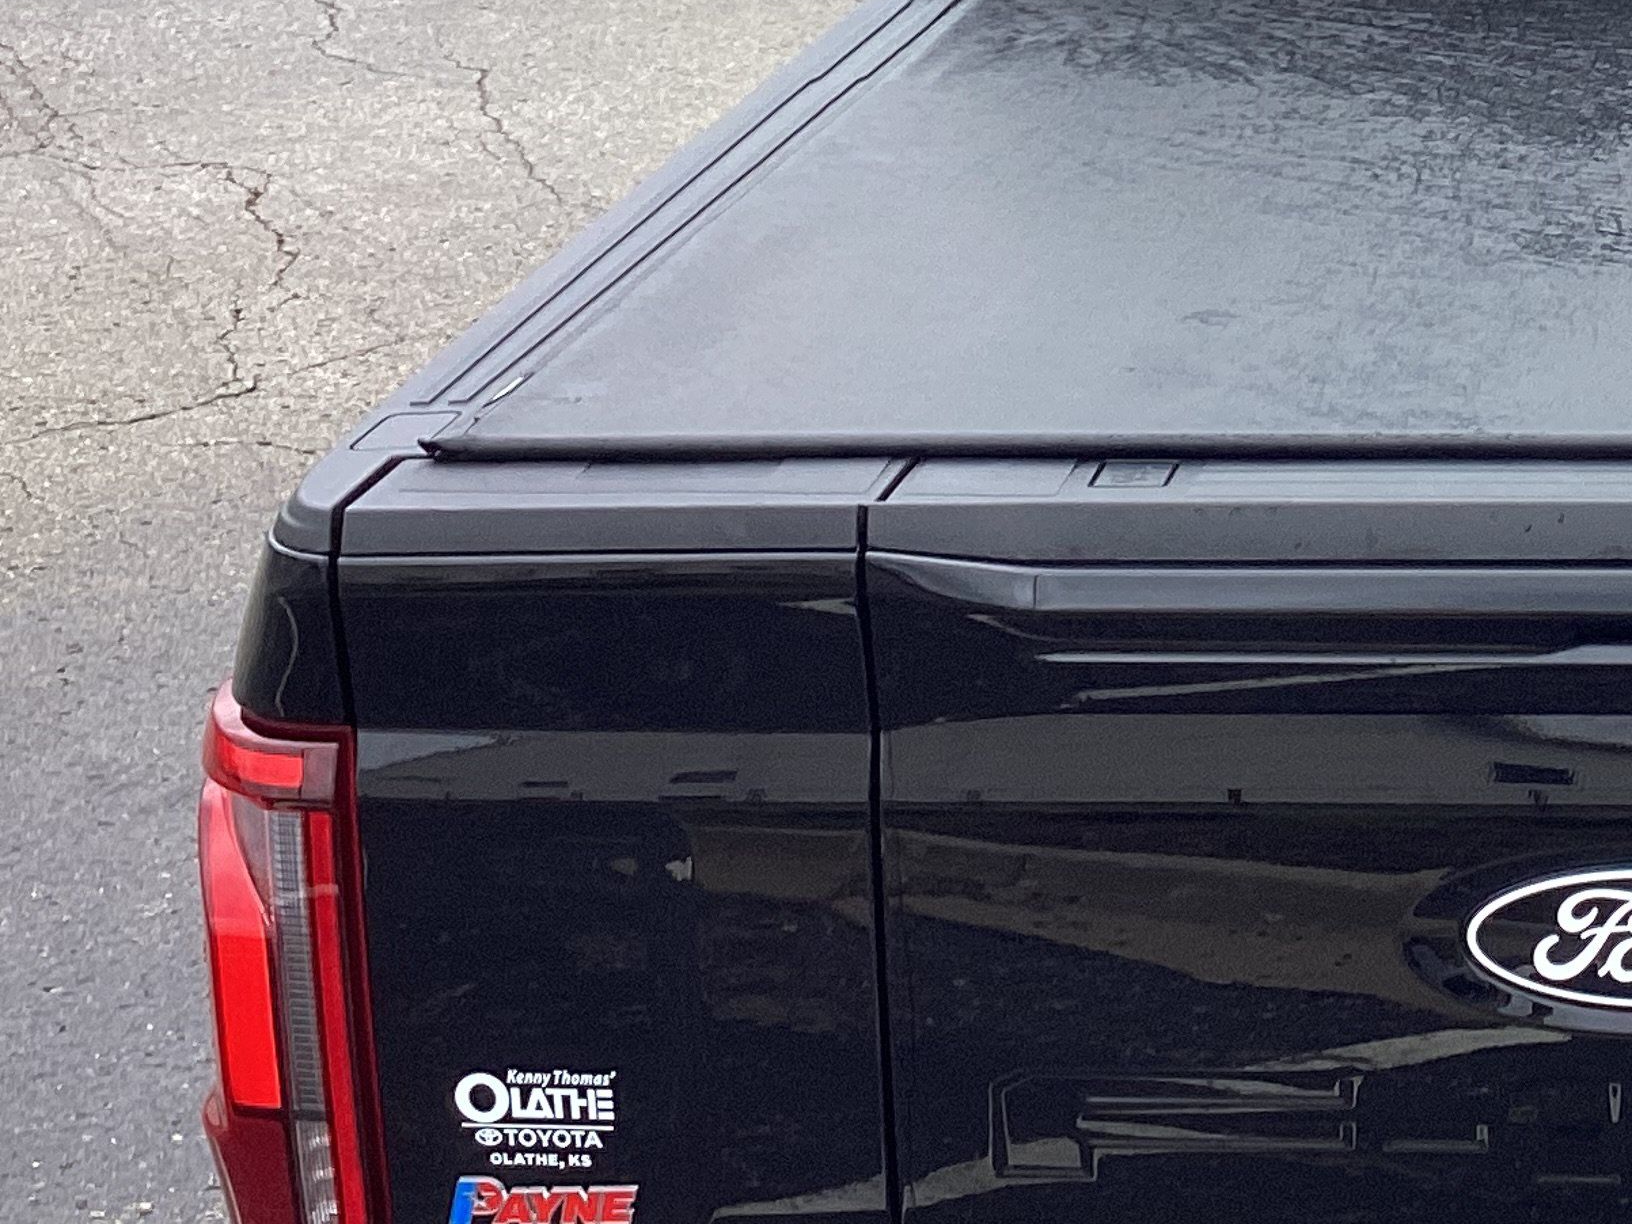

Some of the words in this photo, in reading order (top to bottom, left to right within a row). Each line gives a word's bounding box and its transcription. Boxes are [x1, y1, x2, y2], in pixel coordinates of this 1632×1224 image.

[506, 1069, 551, 1087] Kenny
[455, 1072, 615, 1123] OLATHE
[504, 1129, 604, 1148] TOYOTA
[489, 1152, 566, 1169] OLATHE,
[568, 1154, 593, 1167] KS
[449, 1176, 639, 1224] PAYNE
